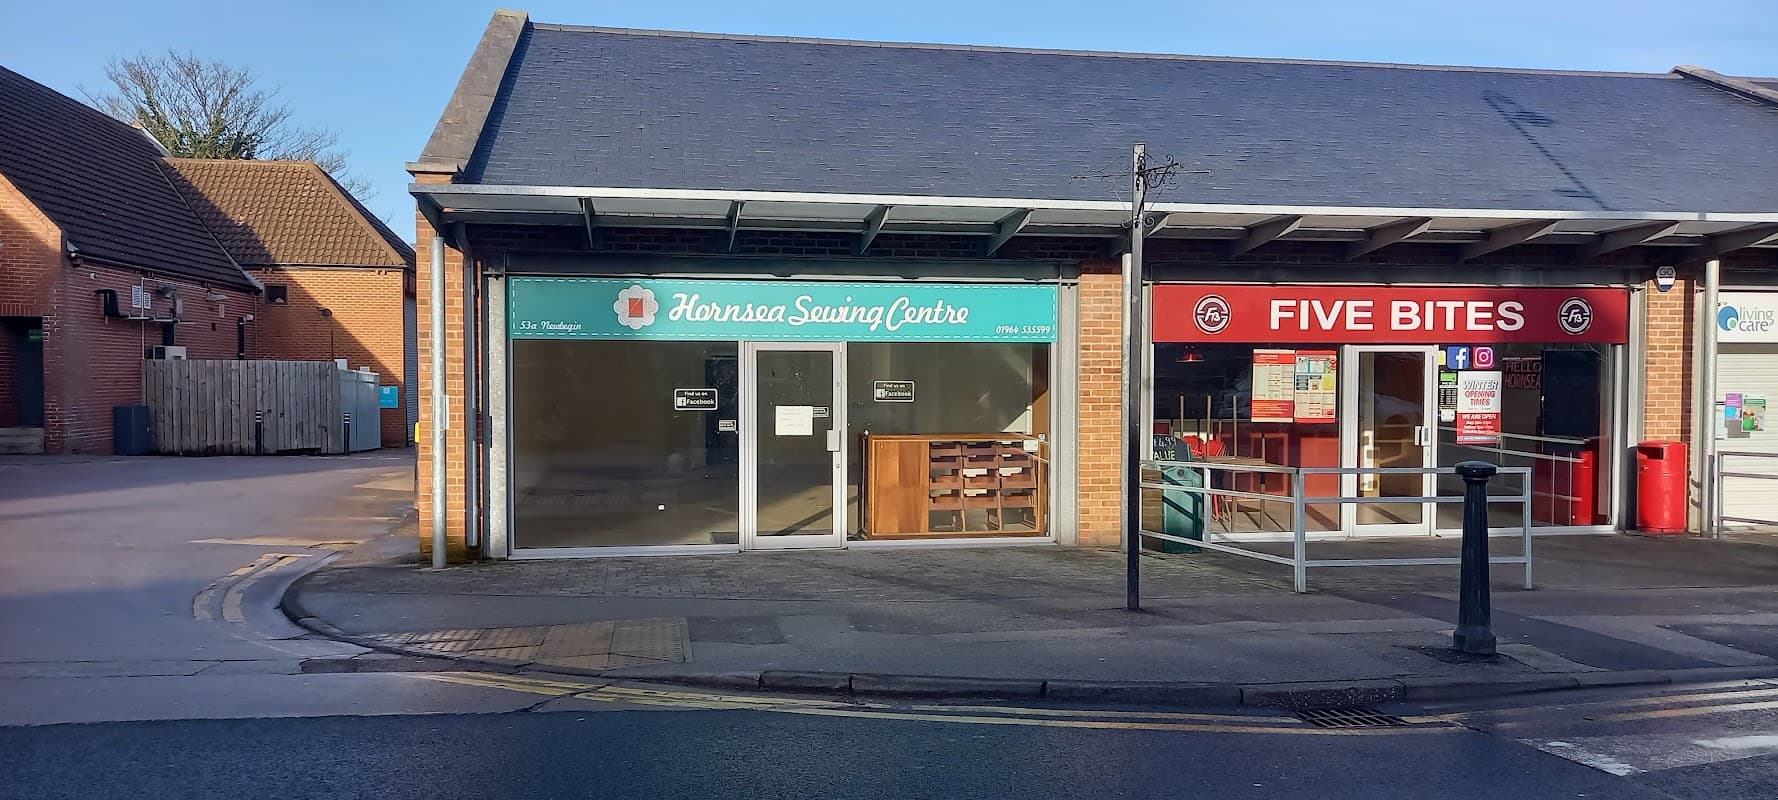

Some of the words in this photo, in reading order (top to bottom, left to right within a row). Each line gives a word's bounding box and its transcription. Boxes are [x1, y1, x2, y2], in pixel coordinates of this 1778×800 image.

[668, 292, 785, 323] Hornsea
[788, 295, 884, 331] Sewing
[885, 296, 969, 331] Centre
[1269, 299, 1374, 331] FIVE
[1390, 299, 1525, 331] BITES
[1739, 306, 1775, 326] living
[519, 320, 538, 330] 53a
[541, 320, 582, 333] Newbegin
[995, 325, 1019, 335] 01964
[1738, 320, 1769, 332] care
[1505, 361, 1542, 373] HELLO
[1464, 380, 1499, 390] WINTER
[1504, 374, 1542, 389] HORNSEA
[1153, 450, 1176, 461] ALUE
